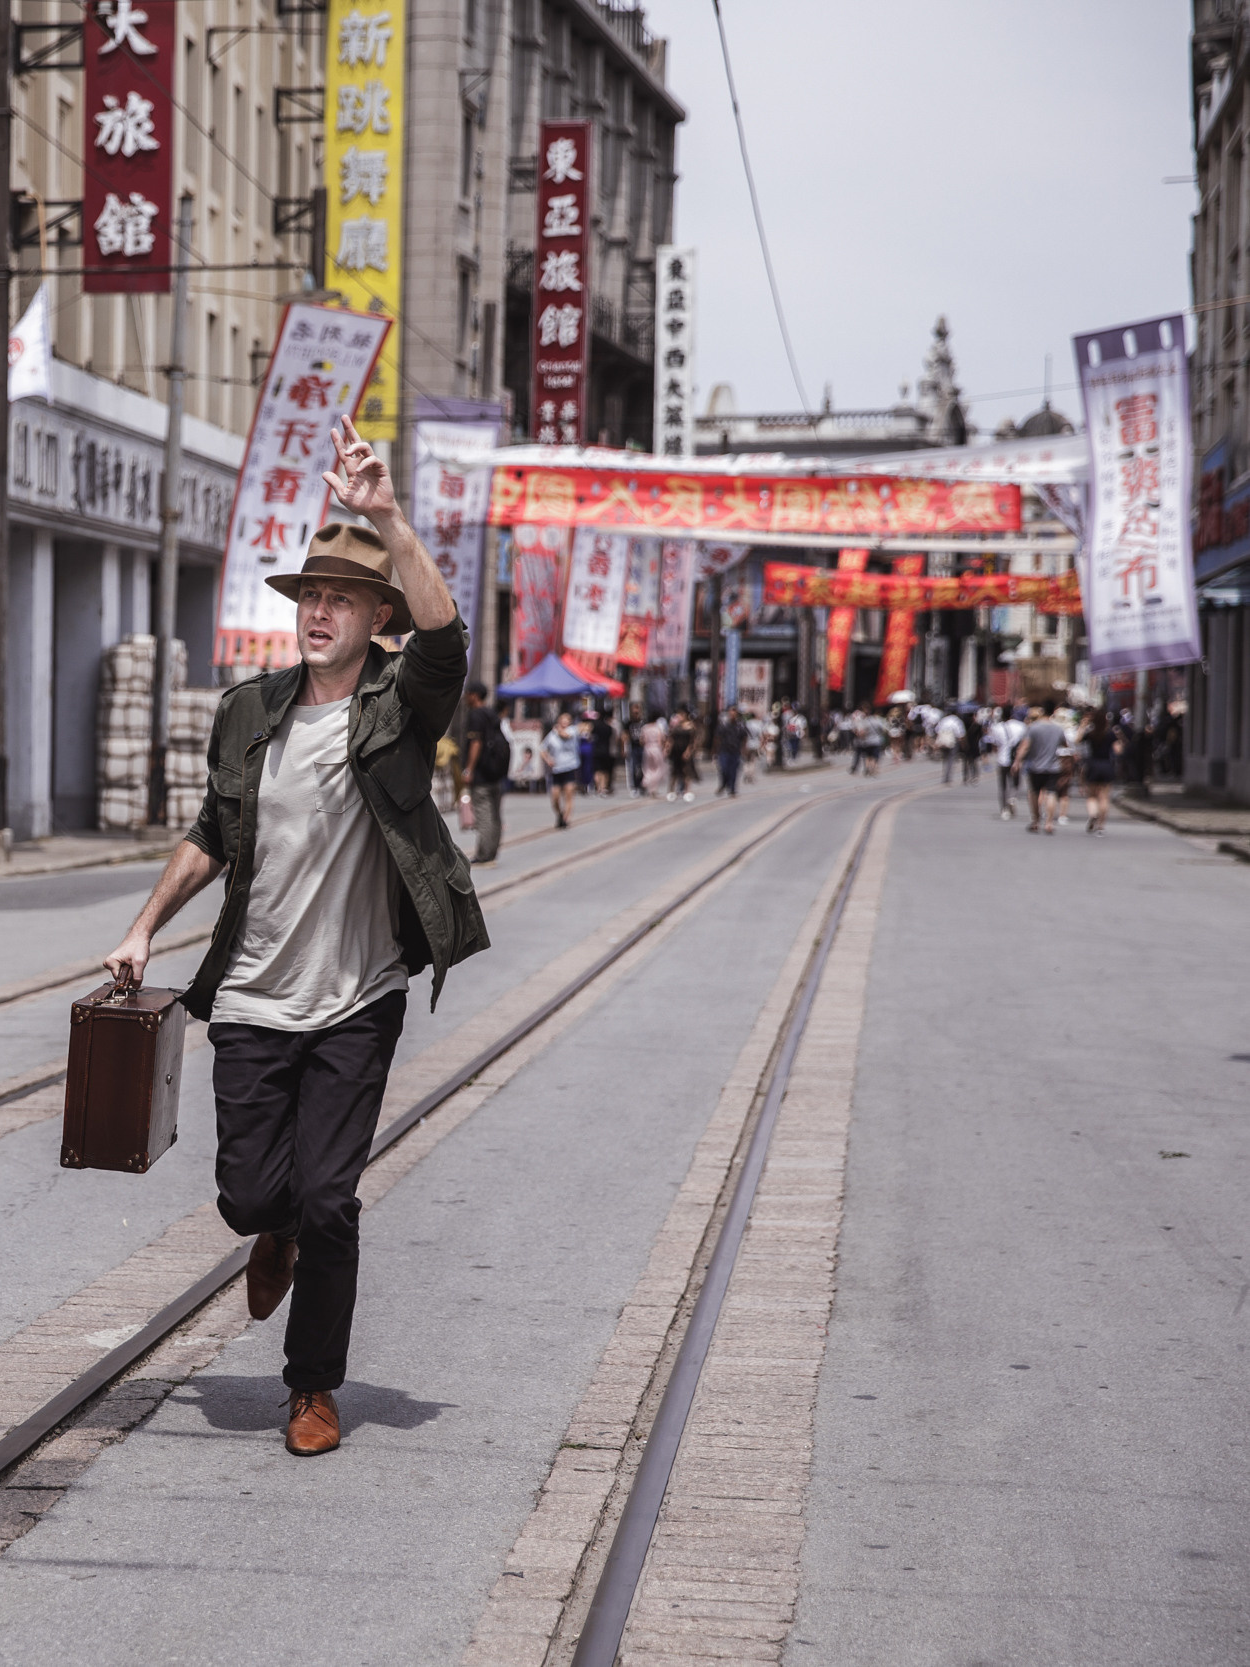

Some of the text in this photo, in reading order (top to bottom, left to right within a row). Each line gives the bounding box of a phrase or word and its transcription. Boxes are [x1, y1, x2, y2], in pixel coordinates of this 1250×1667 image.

[93, 0, 159, 256] 大旅館
[538, 137, 584, 347] 東亞旅館
